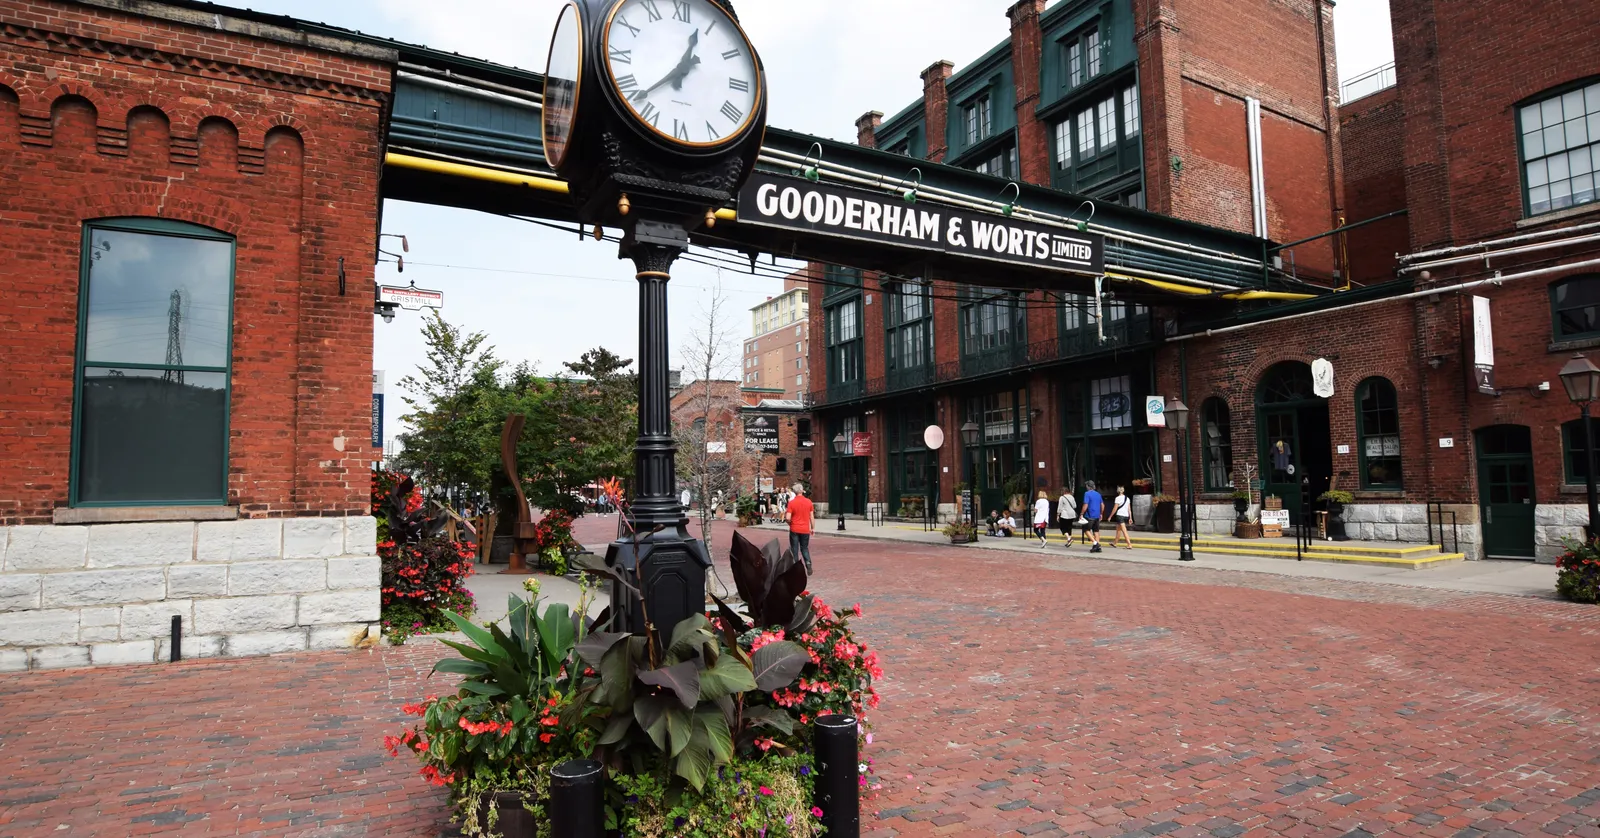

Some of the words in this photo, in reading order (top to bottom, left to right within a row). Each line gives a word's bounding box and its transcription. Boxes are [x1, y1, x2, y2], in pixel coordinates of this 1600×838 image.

[671, 0, 692, 24] XII
[616, 15, 641, 38] X
[704, 19, 717, 36] I
[720, 48, 742, 61] II
[728, 76, 749, 94] III
[756, 182, 941, 243] GOODERHAM
[946, 217, 967, 247] &
[970, 219, 1050, 261] WORTS
[1052, 239, 1092, 260] LIMITED
[390, 294, 433, 306] GRISTMILL
[372, 398, 380, 443] CONTEMPORARY
